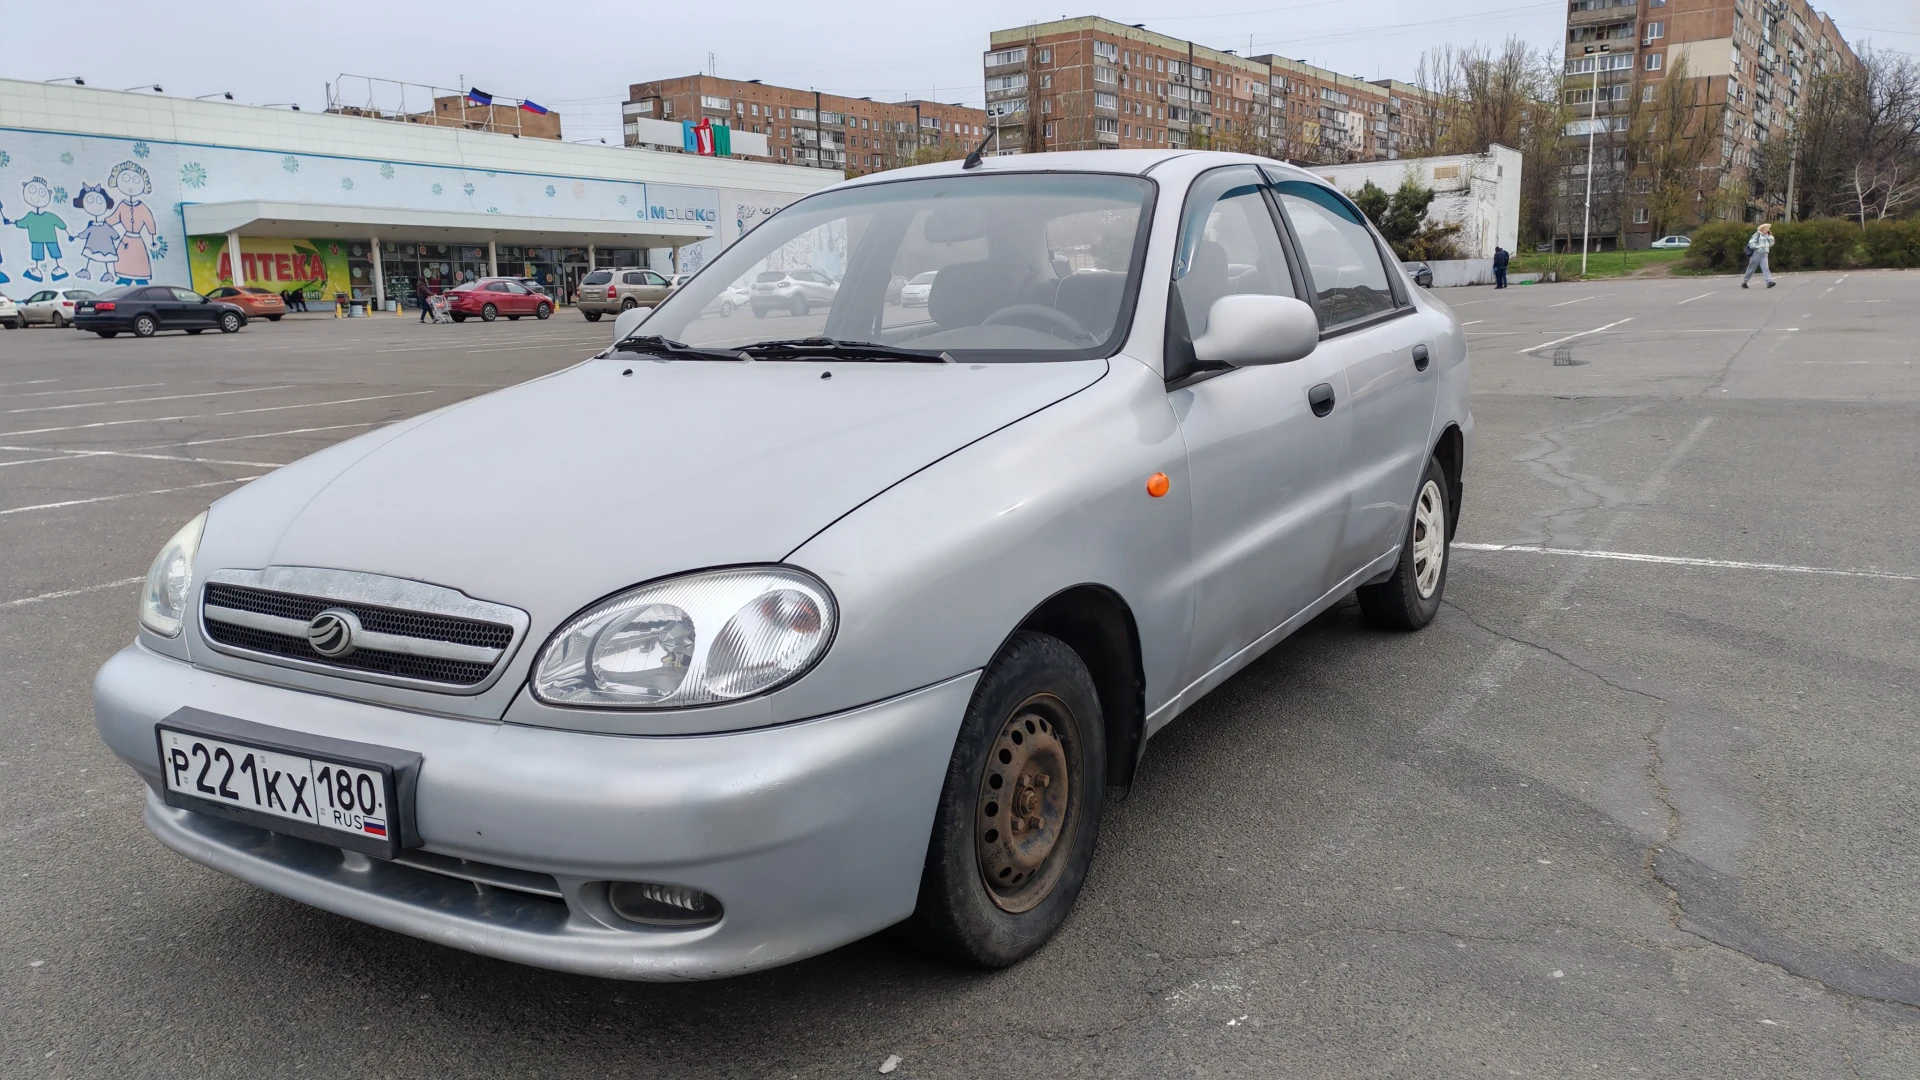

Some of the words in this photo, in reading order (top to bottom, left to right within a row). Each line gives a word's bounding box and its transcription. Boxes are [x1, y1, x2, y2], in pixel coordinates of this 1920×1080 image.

[683, 120, 731, 157] БУМ
[218, 252, 327, 282] АПТЕКА
[316, 766, 376, 816] 180
[333, 809, 363, 830] RUS
